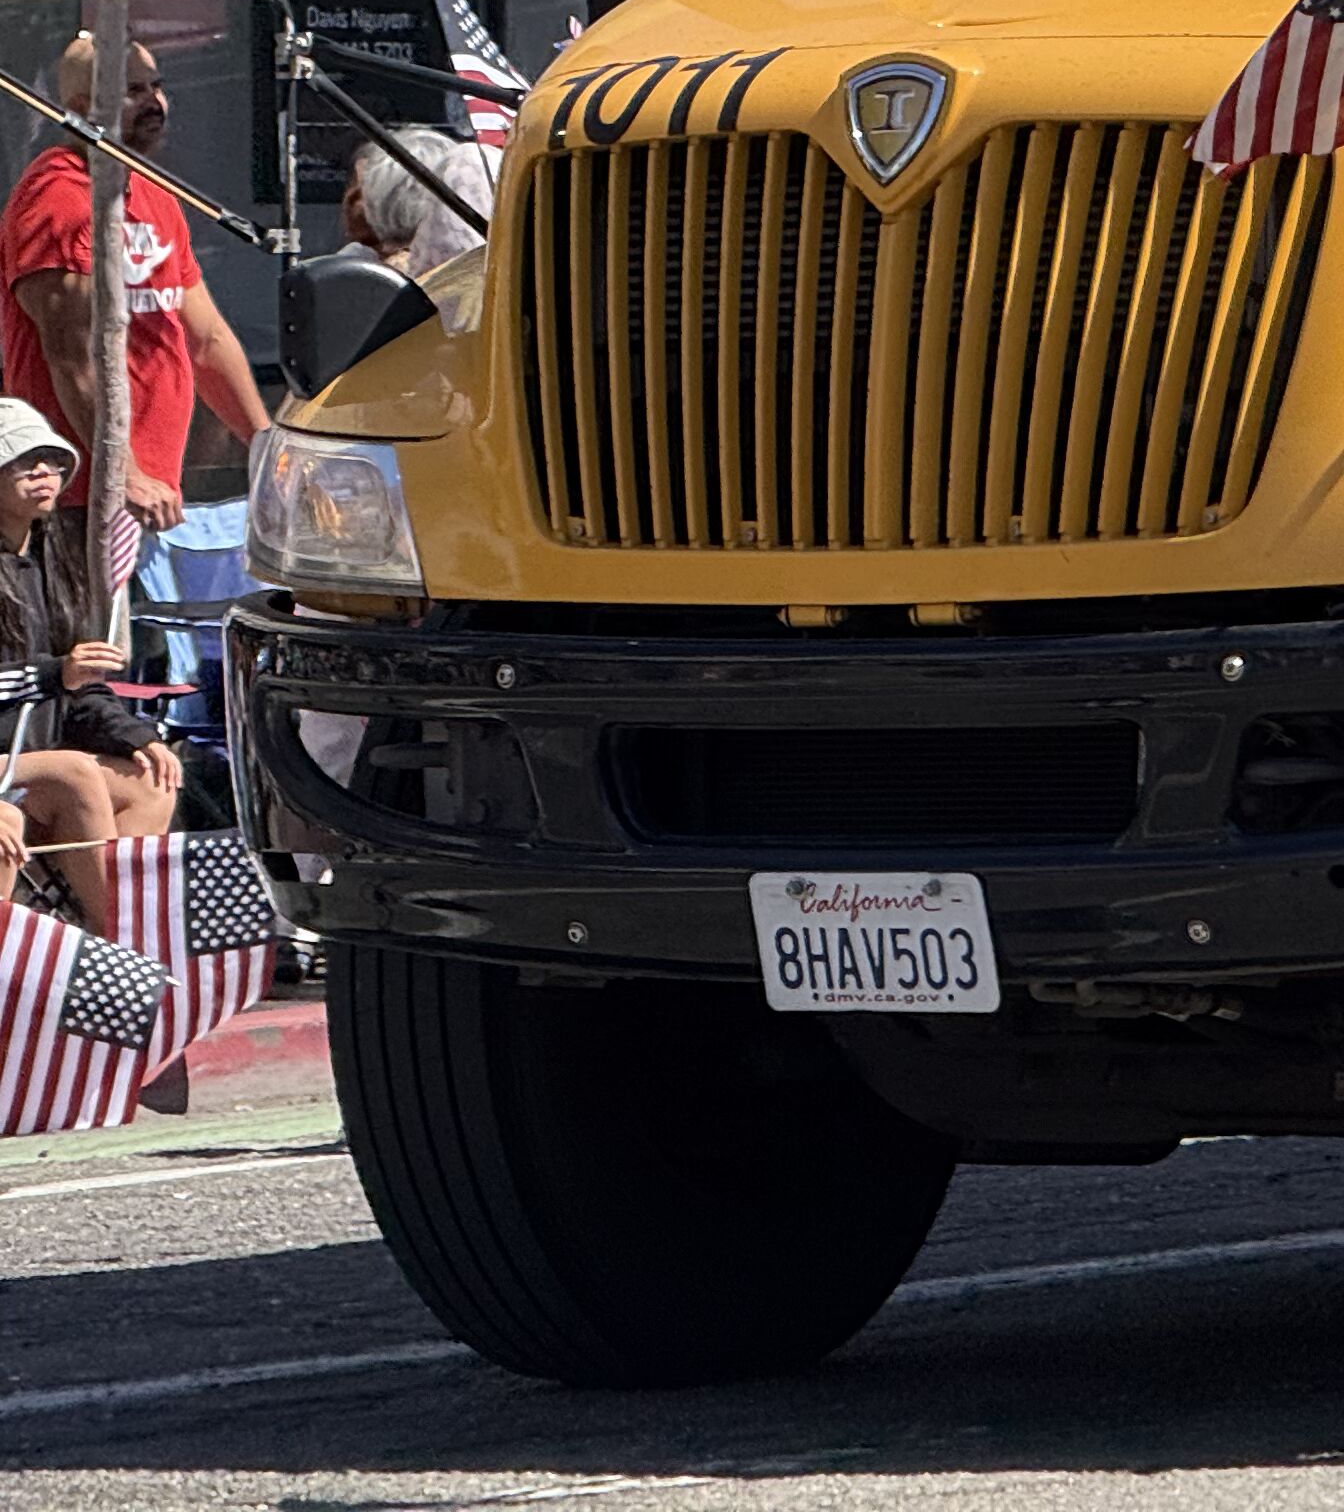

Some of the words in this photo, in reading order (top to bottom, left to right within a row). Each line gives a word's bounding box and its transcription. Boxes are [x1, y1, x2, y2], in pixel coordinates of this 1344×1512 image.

[547, 45, 795, 152] 1011
[800, 881, 942, 923] California
[774, 926, 978, 990] 8HAV503
[823, 992, 940, 1005] dmv.ca.gov
